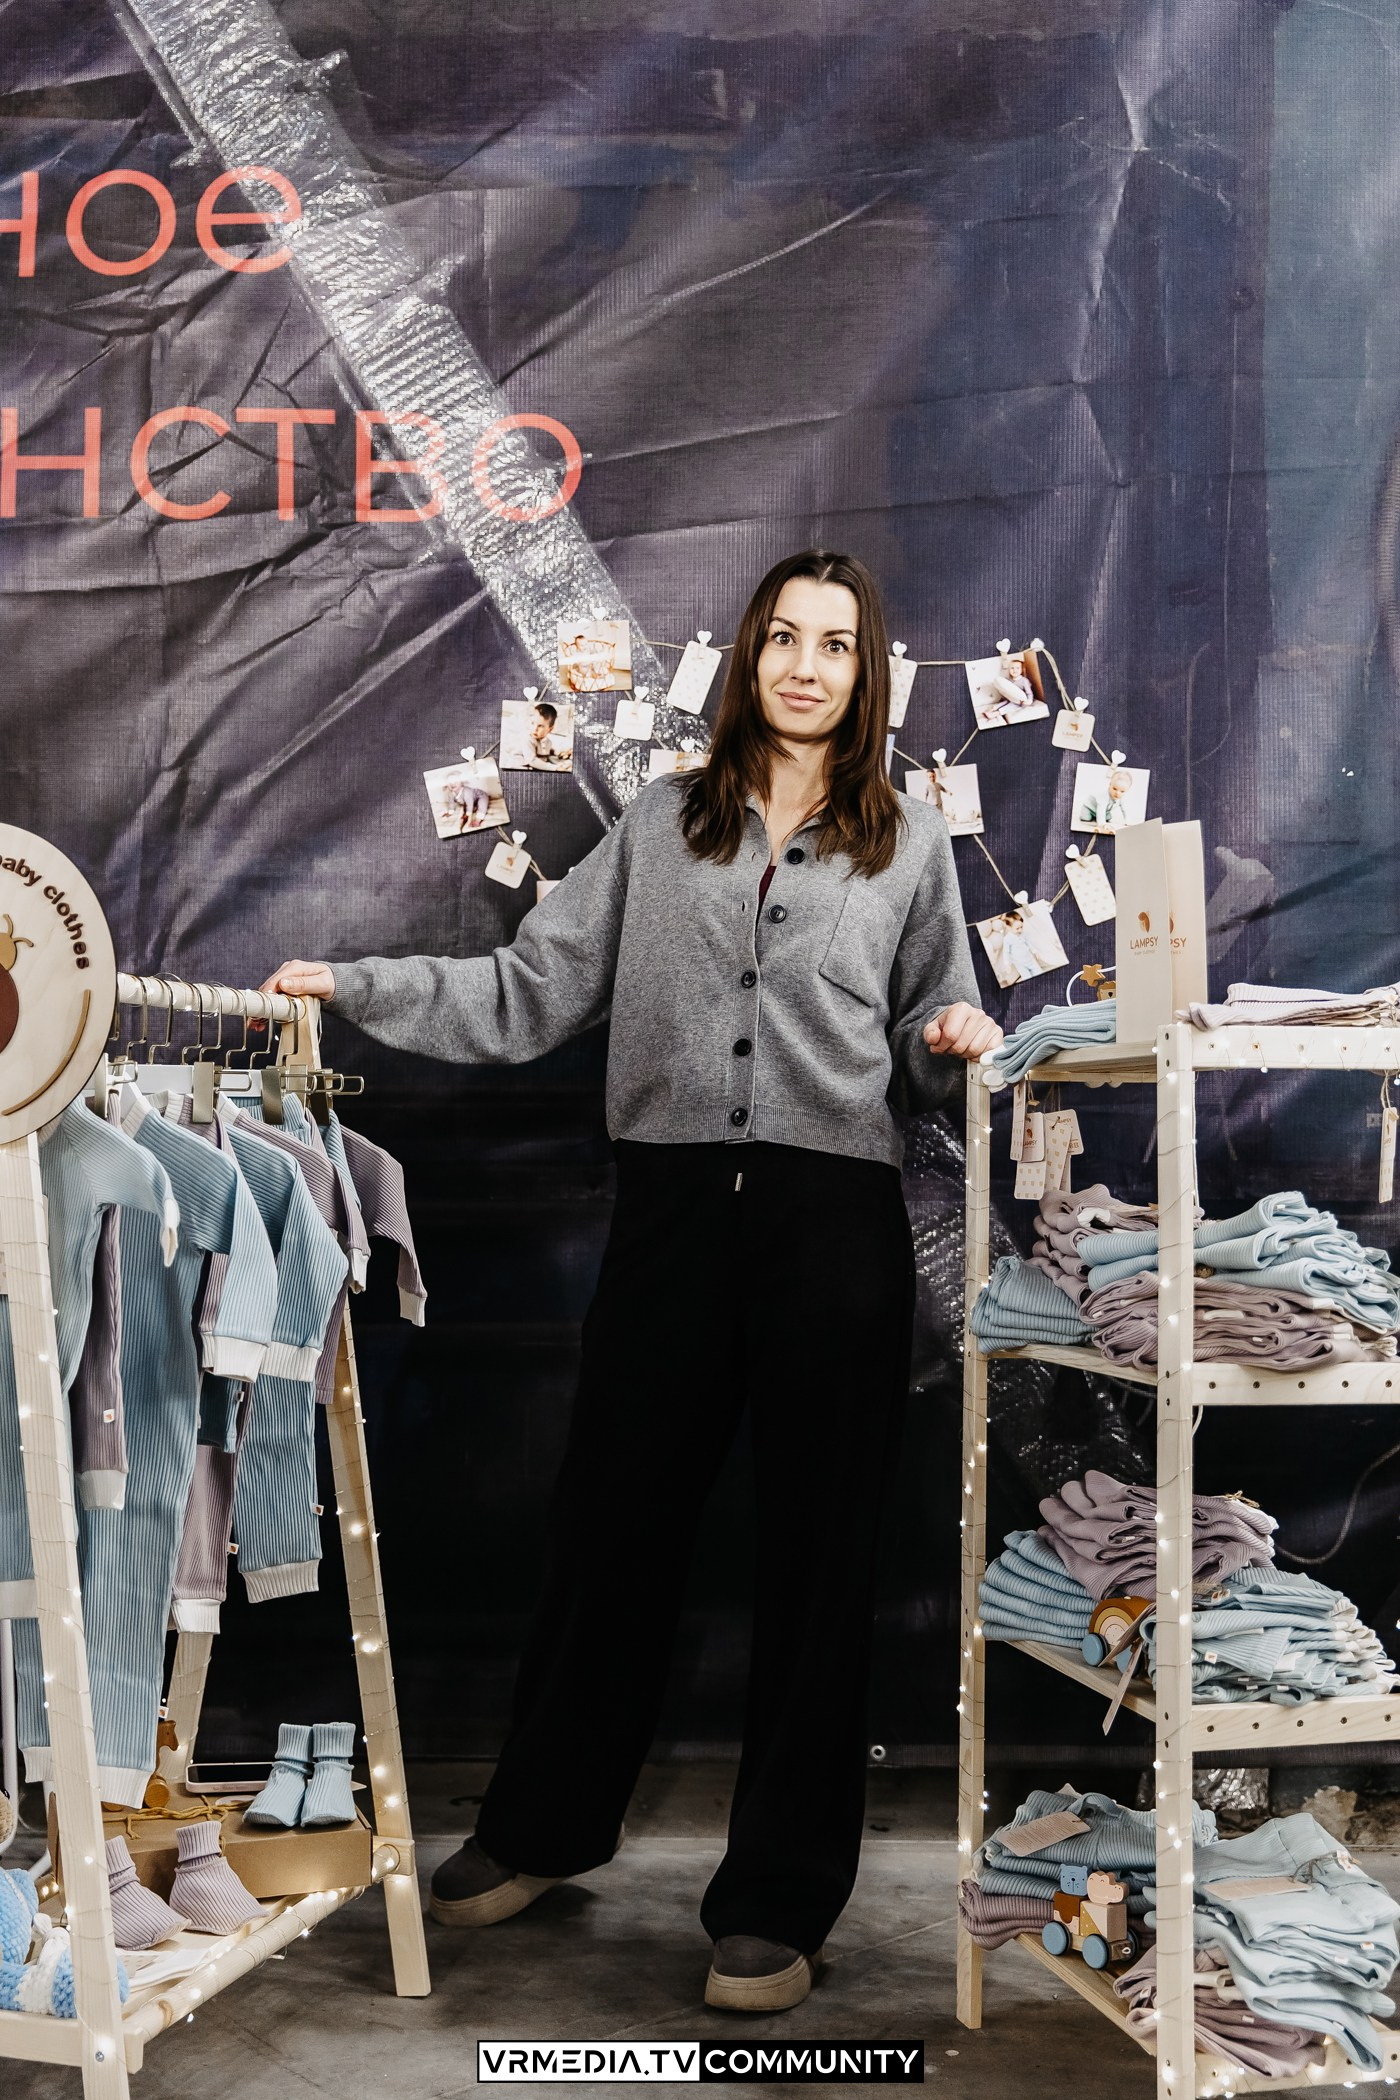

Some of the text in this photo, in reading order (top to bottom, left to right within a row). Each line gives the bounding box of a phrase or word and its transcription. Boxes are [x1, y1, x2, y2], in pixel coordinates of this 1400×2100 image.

[0, 855, 90, 970] aby clothes
[1129, 936, 1158, 950] LAMPSY
